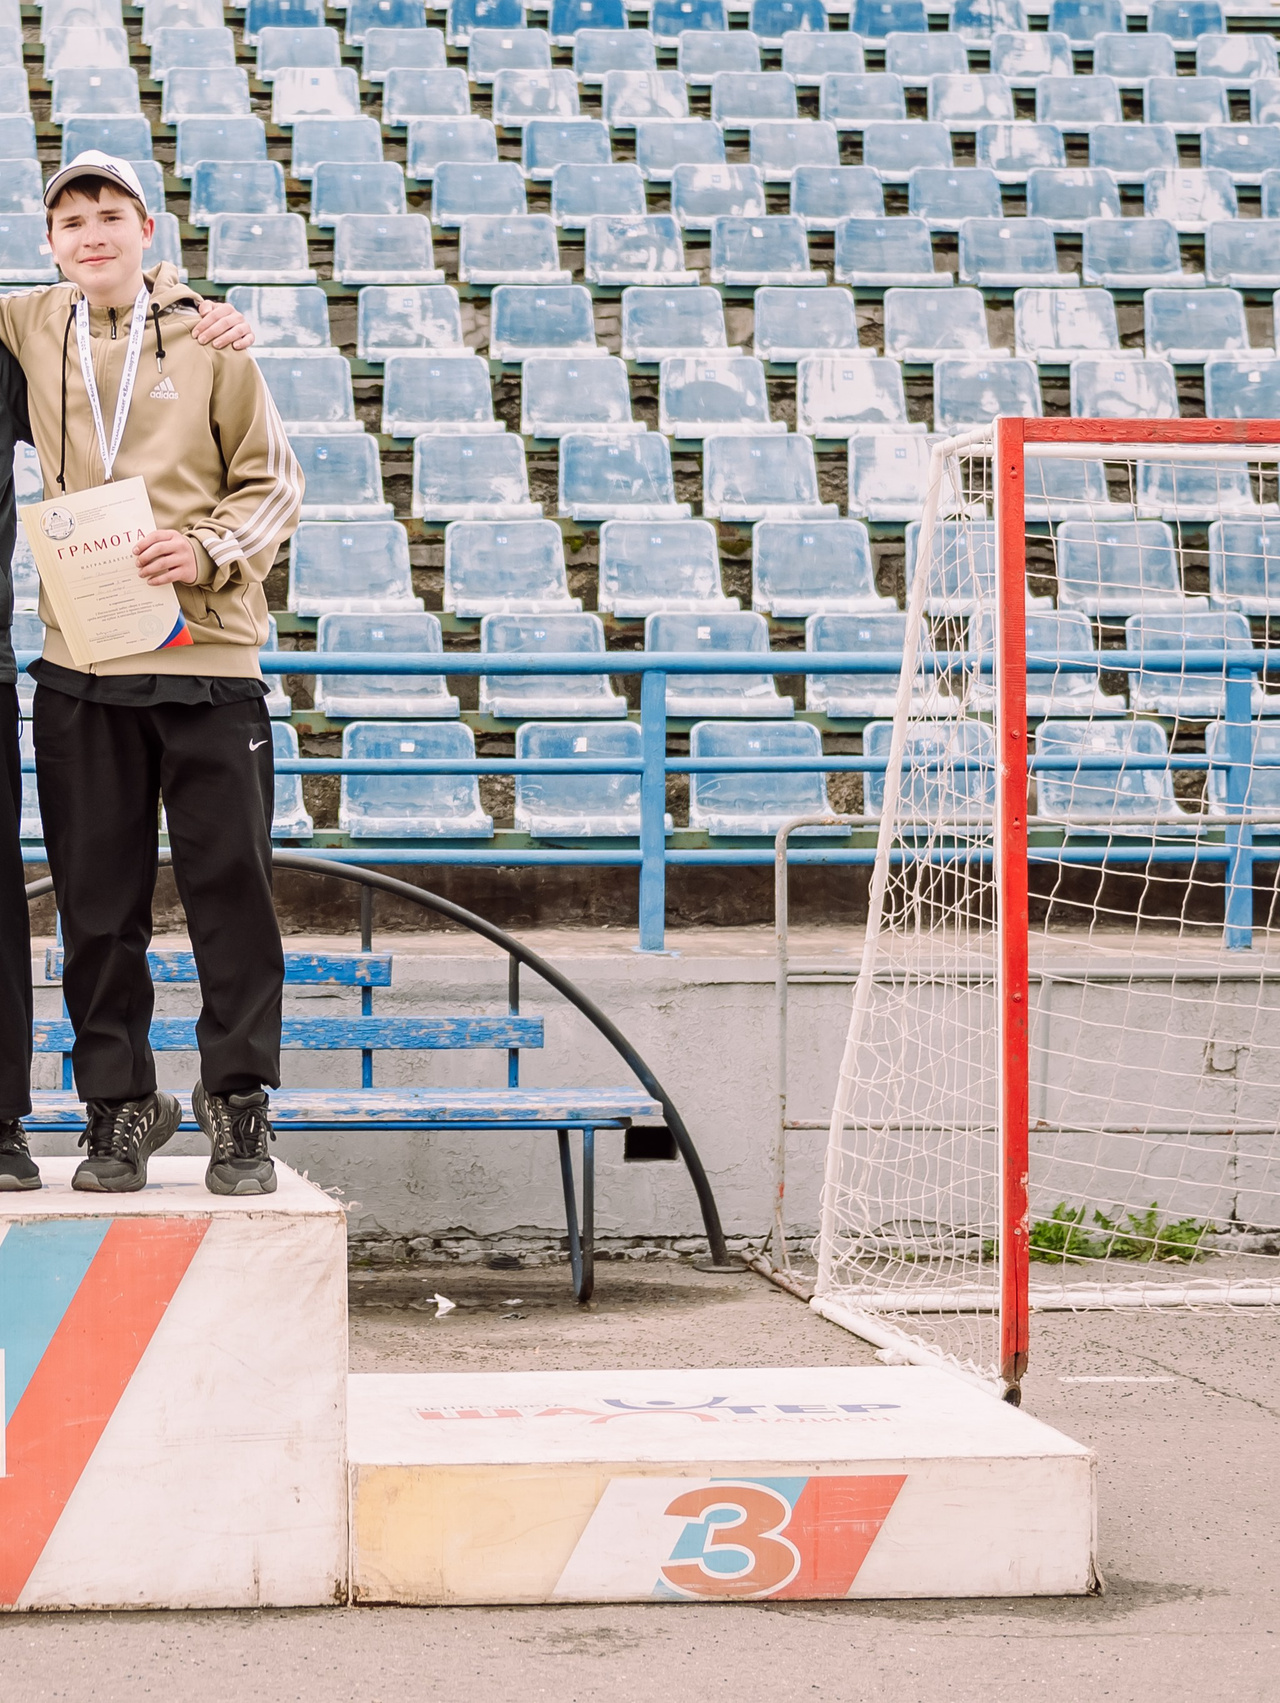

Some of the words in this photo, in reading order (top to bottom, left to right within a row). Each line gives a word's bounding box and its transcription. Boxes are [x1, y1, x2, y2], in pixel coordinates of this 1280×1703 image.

[150, 390, 179, 400] adidas
[57, 528, 146, 560] ГРАМОТА
[81, 554, 134, 570] НАГРАЖДАЕТСЯ
[660, 1480, 801, 1598] 3
